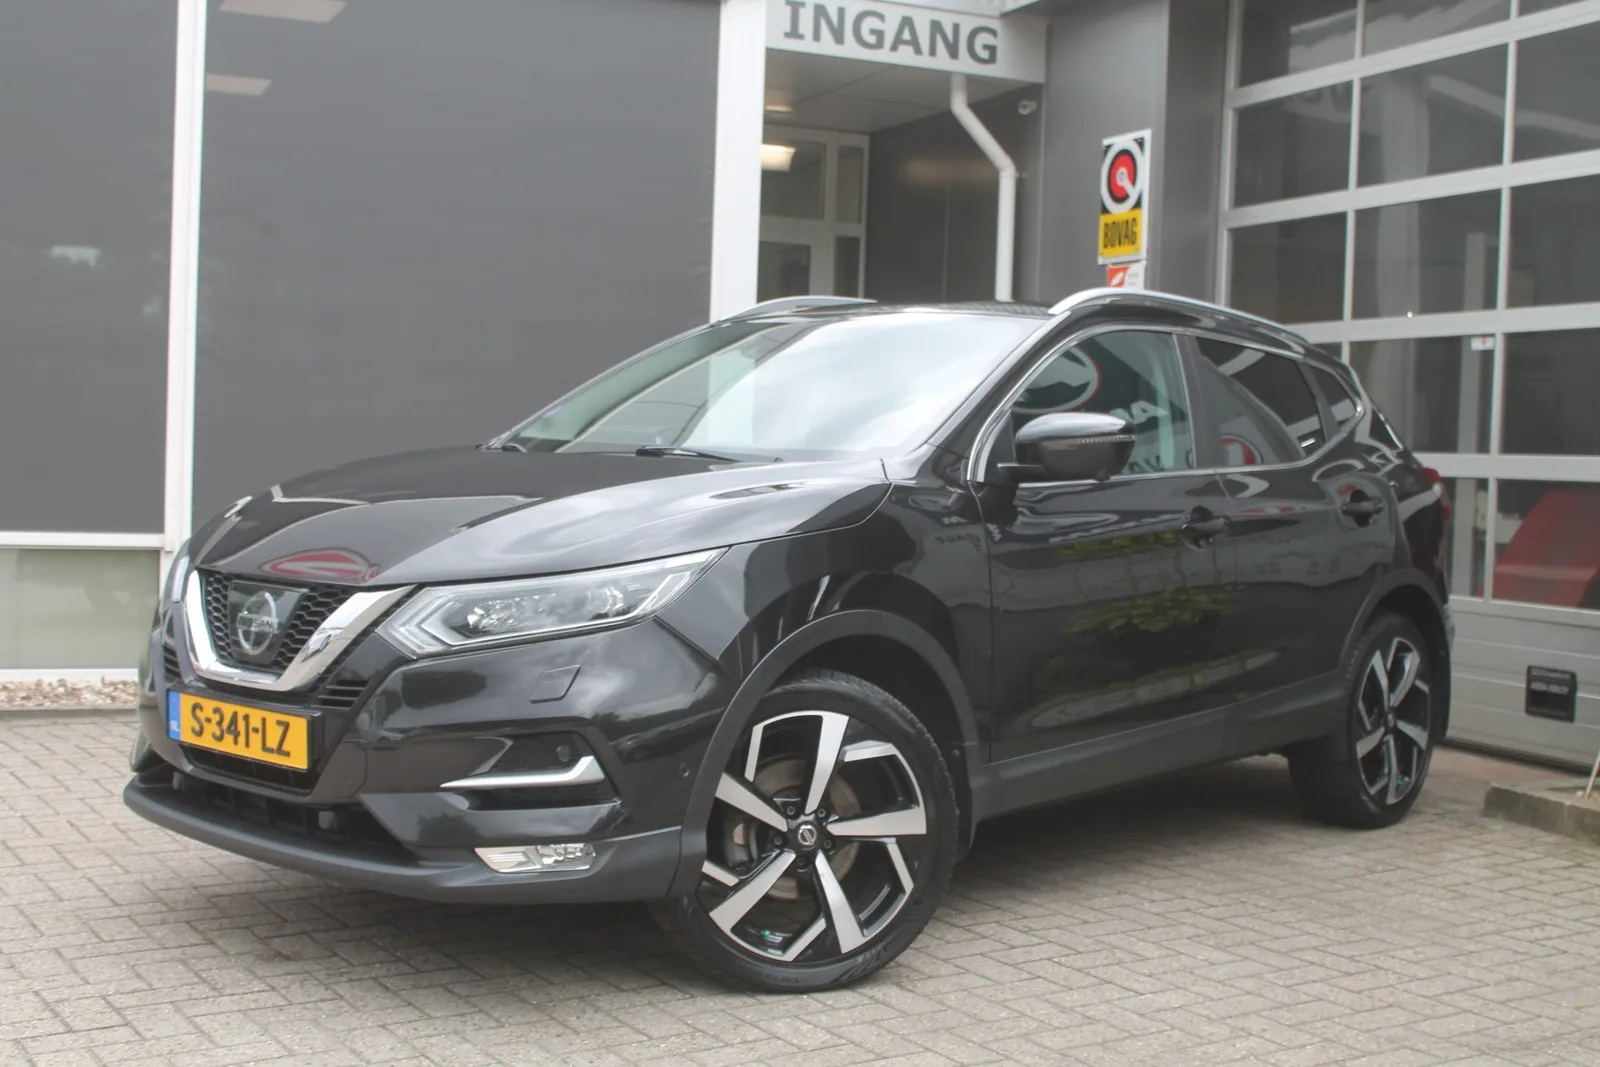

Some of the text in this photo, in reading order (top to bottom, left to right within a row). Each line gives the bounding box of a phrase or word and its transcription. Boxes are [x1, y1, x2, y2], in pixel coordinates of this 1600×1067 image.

[783, 0, 999, 66] INGANG
[1103, 218, 1138, 249] BOVAG
[190, 702, 291, 757] S-341-LZ
